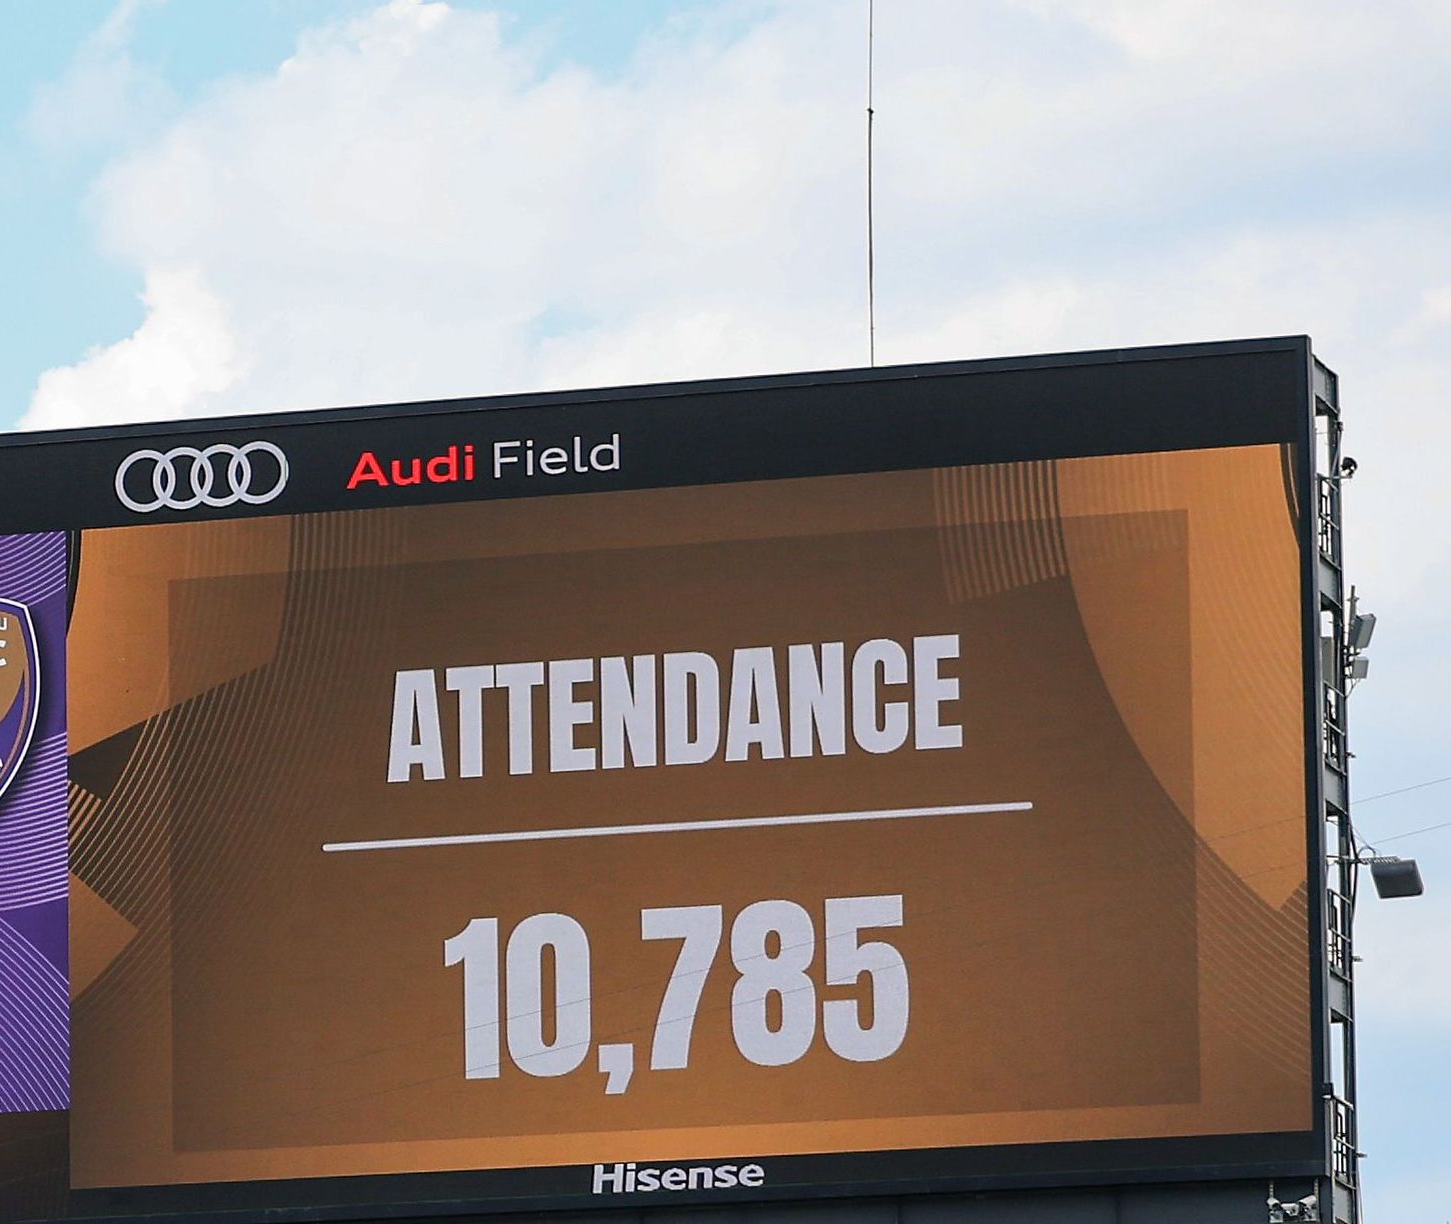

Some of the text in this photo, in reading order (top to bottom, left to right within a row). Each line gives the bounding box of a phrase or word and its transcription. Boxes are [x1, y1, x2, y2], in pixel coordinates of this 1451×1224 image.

[346, 434, 621, 489] Audi Field
[387, 634, 963, 783] ATTENDANCE
[444, 893, 911, 1095] 10,785
[592, 1163, 765, 1194] Hisense
